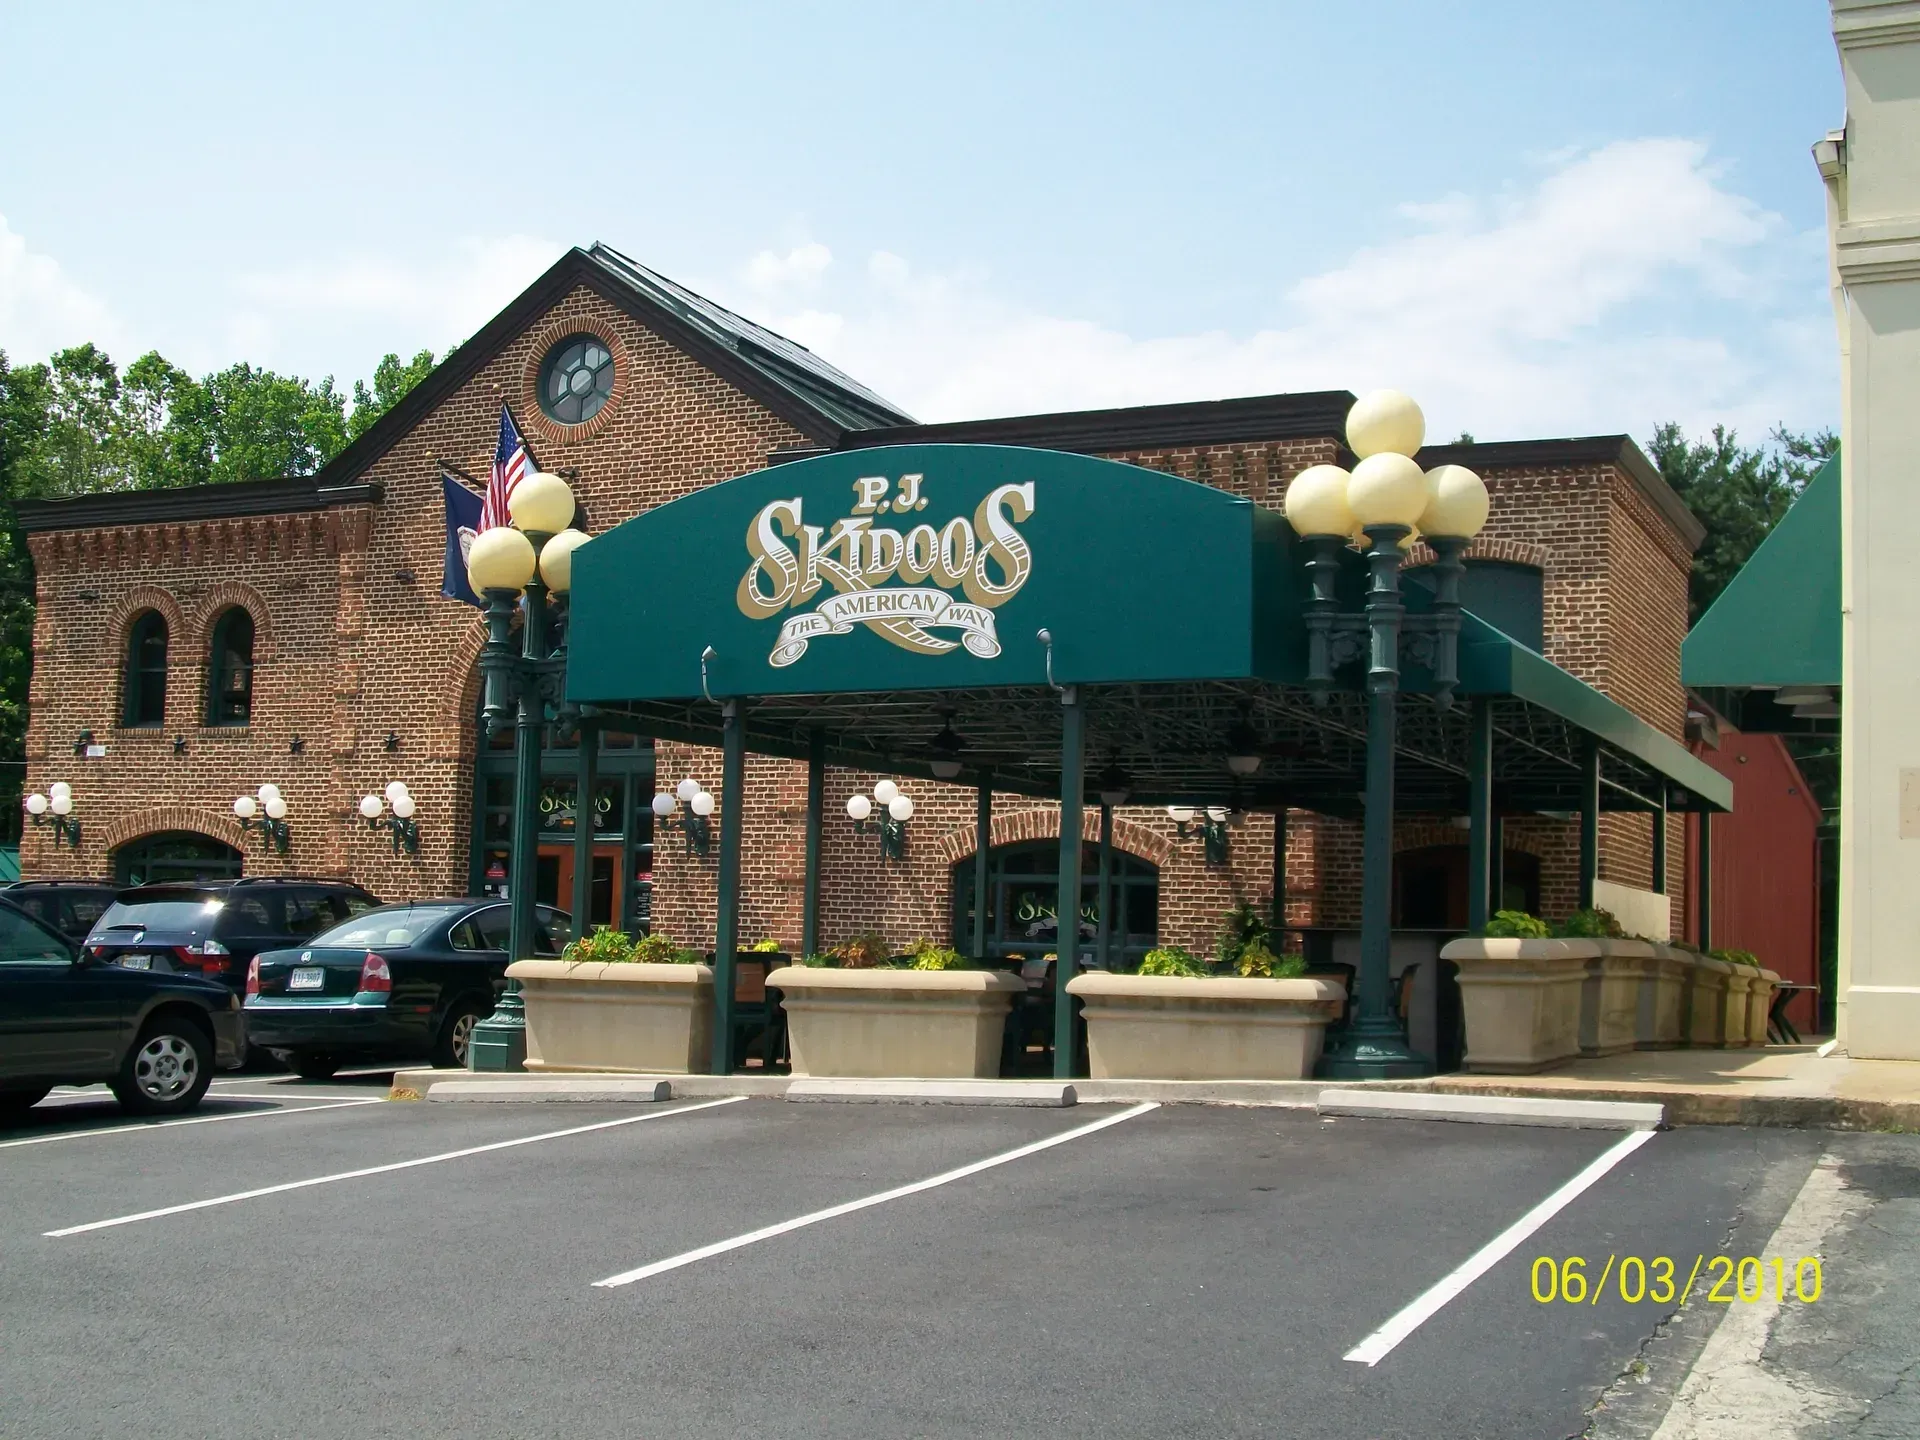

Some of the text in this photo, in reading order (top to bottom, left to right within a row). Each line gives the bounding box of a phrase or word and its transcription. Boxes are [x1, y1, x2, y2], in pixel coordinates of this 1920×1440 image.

[853, 473, 929, 513] P.J.
[739, 481, 1036, 615] SKIDOOS
[789, 593, 989, 637] THE AMERICAN WAY
